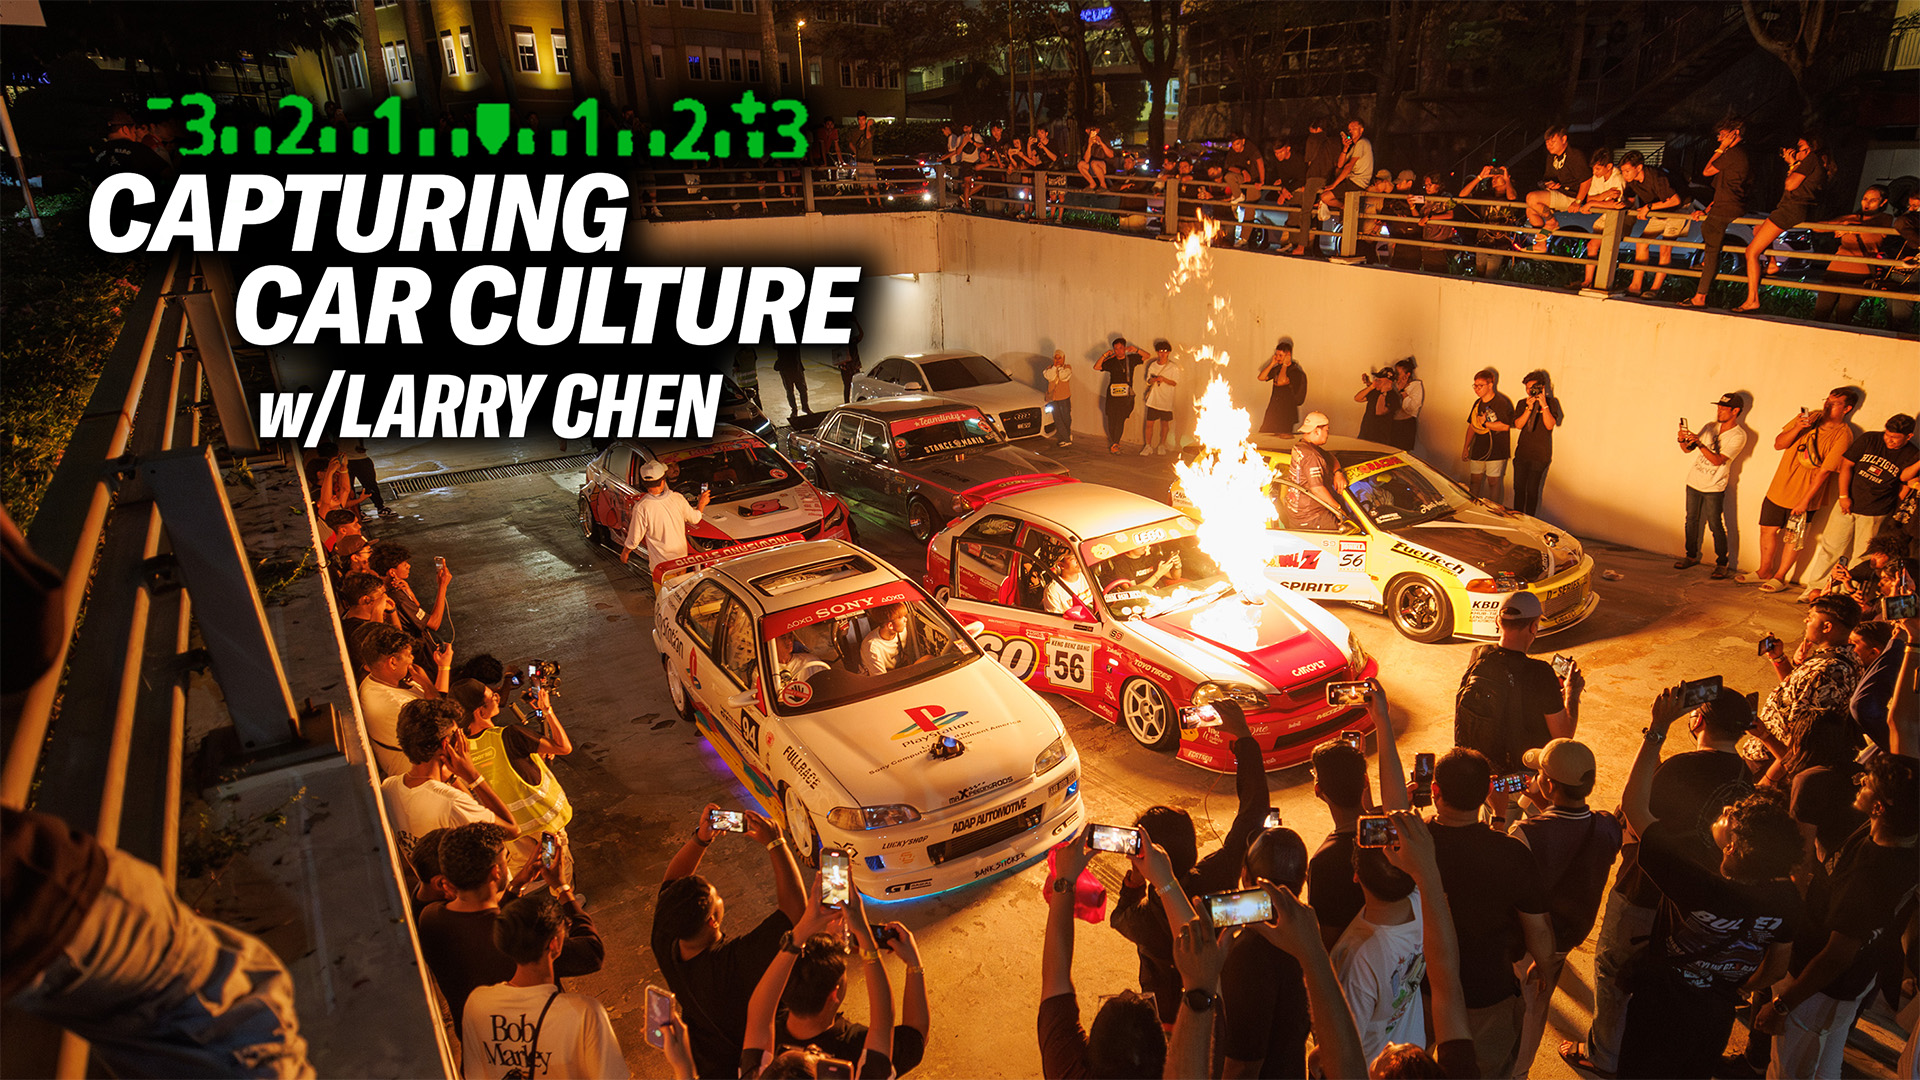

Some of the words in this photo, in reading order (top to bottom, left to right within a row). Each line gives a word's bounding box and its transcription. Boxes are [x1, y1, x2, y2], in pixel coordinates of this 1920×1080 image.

[924, 441, 954, 454] STANCE
[961, 436, 985, 449] MANIA
[1859, 453, 1900, 477] HILFIGER
[675, 550, 720, 566] STUDIO
[1340, 554, 1364, 567] 56
[1393, 541, 1465, 575] FuelTech
[816, 597, 874, 619] SONY
[1472, 601, 1499, 609] KBD
[1051, 640, 1064, 648] KENG
[1064, 641, 1077, 649] BENZ
[1054, 650, 1085, 684] 56
[1134, 659, 1153, 673] TOYO
[1151, 667, 1173, 682] TIRES
[742, 717, 757, 749] 94
[902, 720, 974, 748] PlayStation
[869, 764, 890, 775] Sony
[990, 720, 1022, 731] America
[783, 745, 821, 790] FULLRACE
[952, 816, 976, 834] ADAP
[976, 798, 1027, 827] AUTOMOTIVE
[975, 865, 994, 879] BANK
[996, 852, 1027, 869] STICKER
[1691, 910, 1782, 930] BULET
[490, 1013, 537, 1043] Bob
[483, 1041, 552, 1075] Marley
